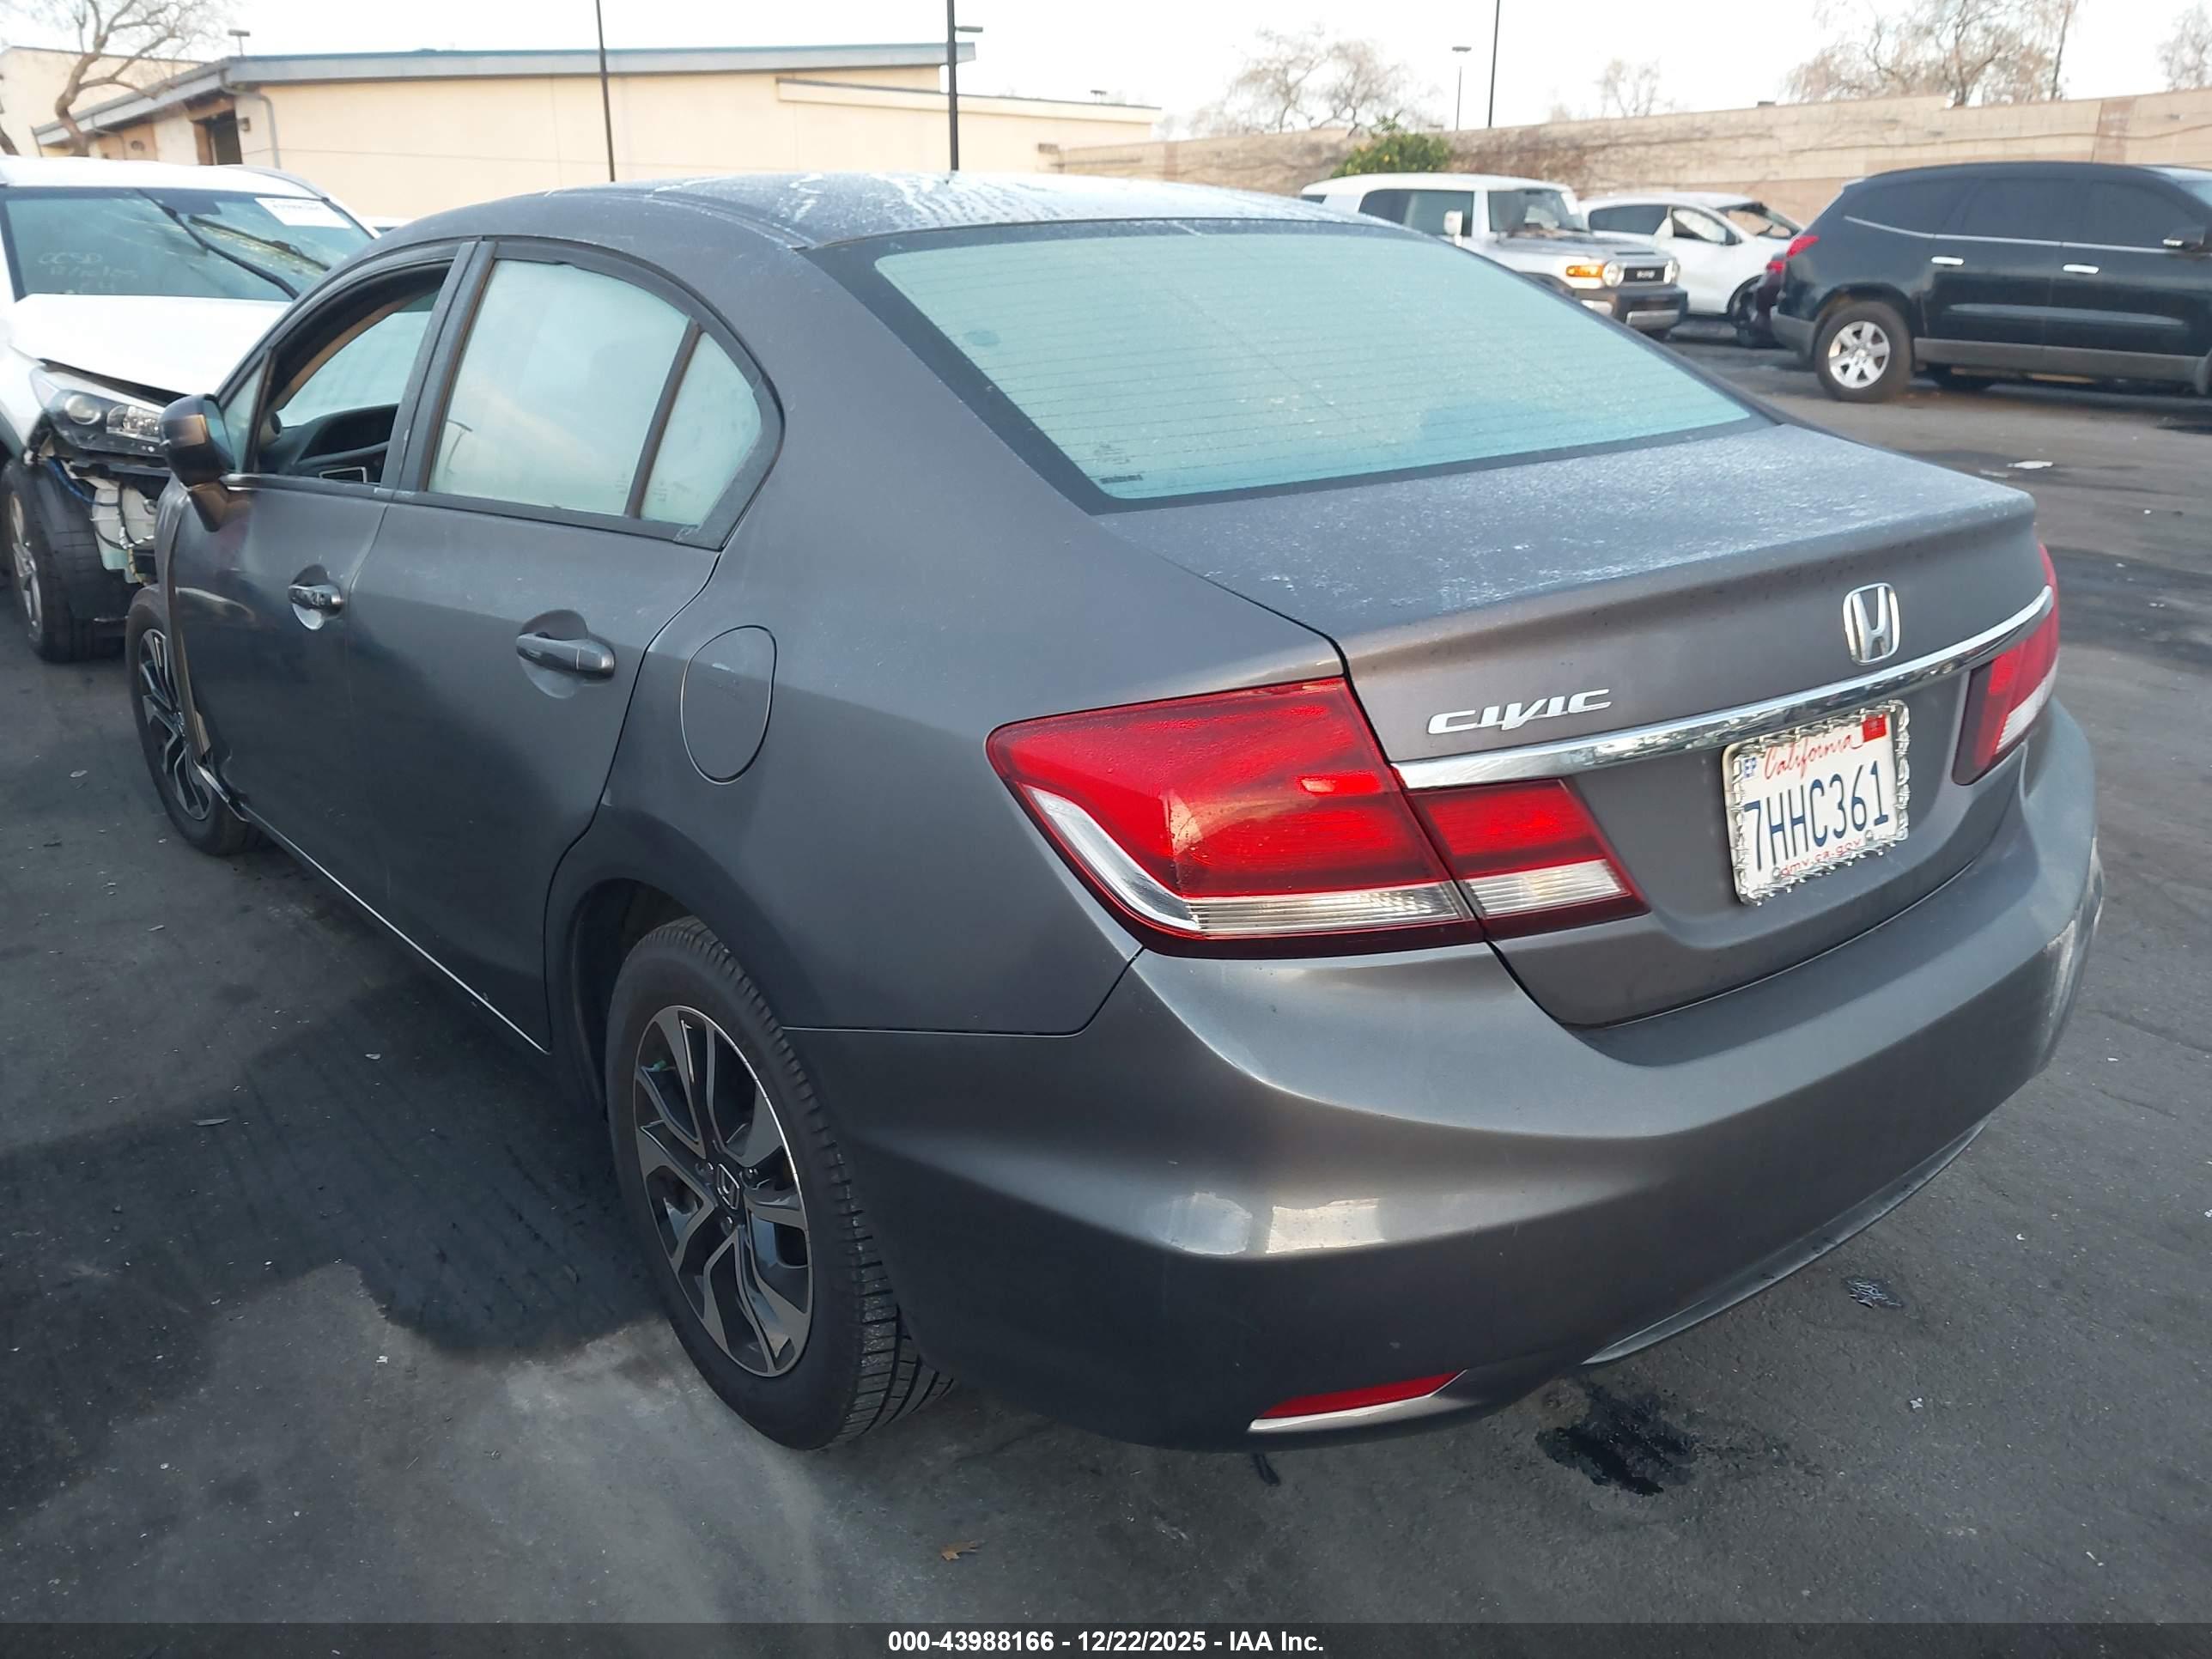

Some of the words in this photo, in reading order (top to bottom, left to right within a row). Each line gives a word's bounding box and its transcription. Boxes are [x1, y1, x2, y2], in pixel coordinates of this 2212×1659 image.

[1428, 689, 1612, 734] CIVIC
[1764, 732, 1863, 780] California
[1744, 760, 1889, 872] 7HHC361
